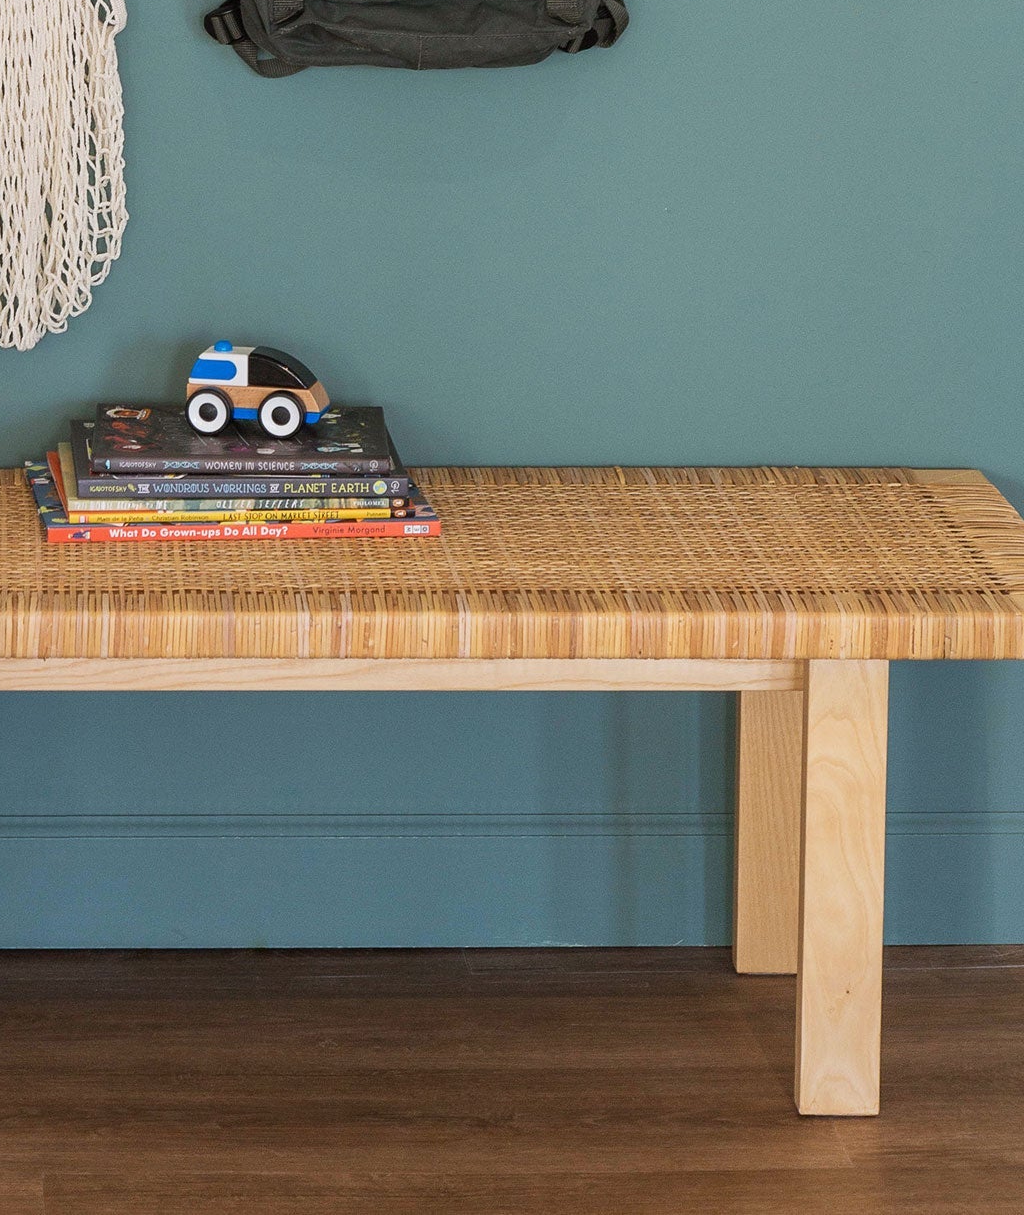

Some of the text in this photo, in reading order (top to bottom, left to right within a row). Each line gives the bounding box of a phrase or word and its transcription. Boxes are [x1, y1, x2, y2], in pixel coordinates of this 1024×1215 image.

[205, 461, 295, 471] WOMEN IN SCIENCE
[153, 484, 209, 494] WONDROUS
[213, 483, 267, 494] WORKINGS
[284, 482, 327, 494] PLANET
[331, 482, 369, 493] EARTH
[222, 511, 339, 521] LAST STOP ON MARKET STREET
[109, 526, 289, 539] What Do Grown-ups Do All Day?
[312, 525, 386, 535] Virginie Morgand
